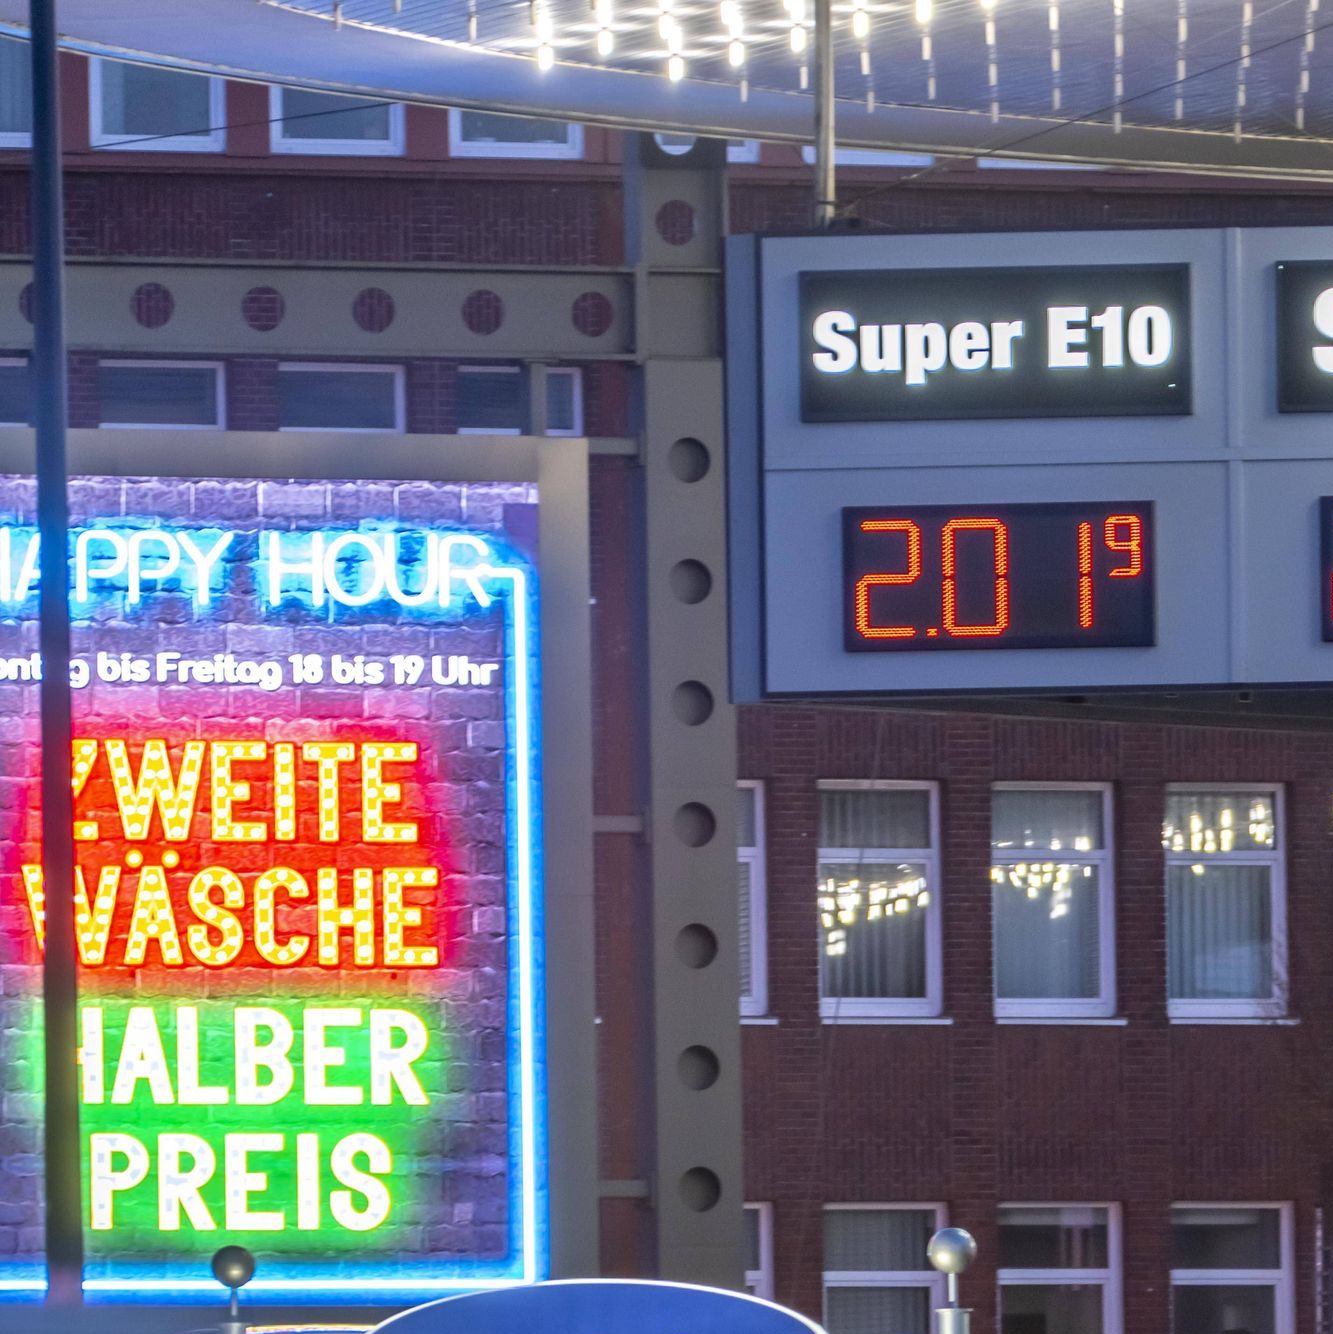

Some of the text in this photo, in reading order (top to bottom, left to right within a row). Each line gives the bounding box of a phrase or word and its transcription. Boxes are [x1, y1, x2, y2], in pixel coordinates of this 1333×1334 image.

[812, 305, 1173, 386] Super E10
[268, 532, 492, 608] HOUR
[97, 651, 151, 683] bis
[156, 651, 283, 691] Freitag
[288, 653, 324, 684] 18
[331, 654, 385, 684] bis
[389, 654, 425, 685] 19
[431, 655, 499, 685] Uhr
[21, 850, 439, 966] WÄSCHE
[90, 1132, 392, 1231] PREIS
